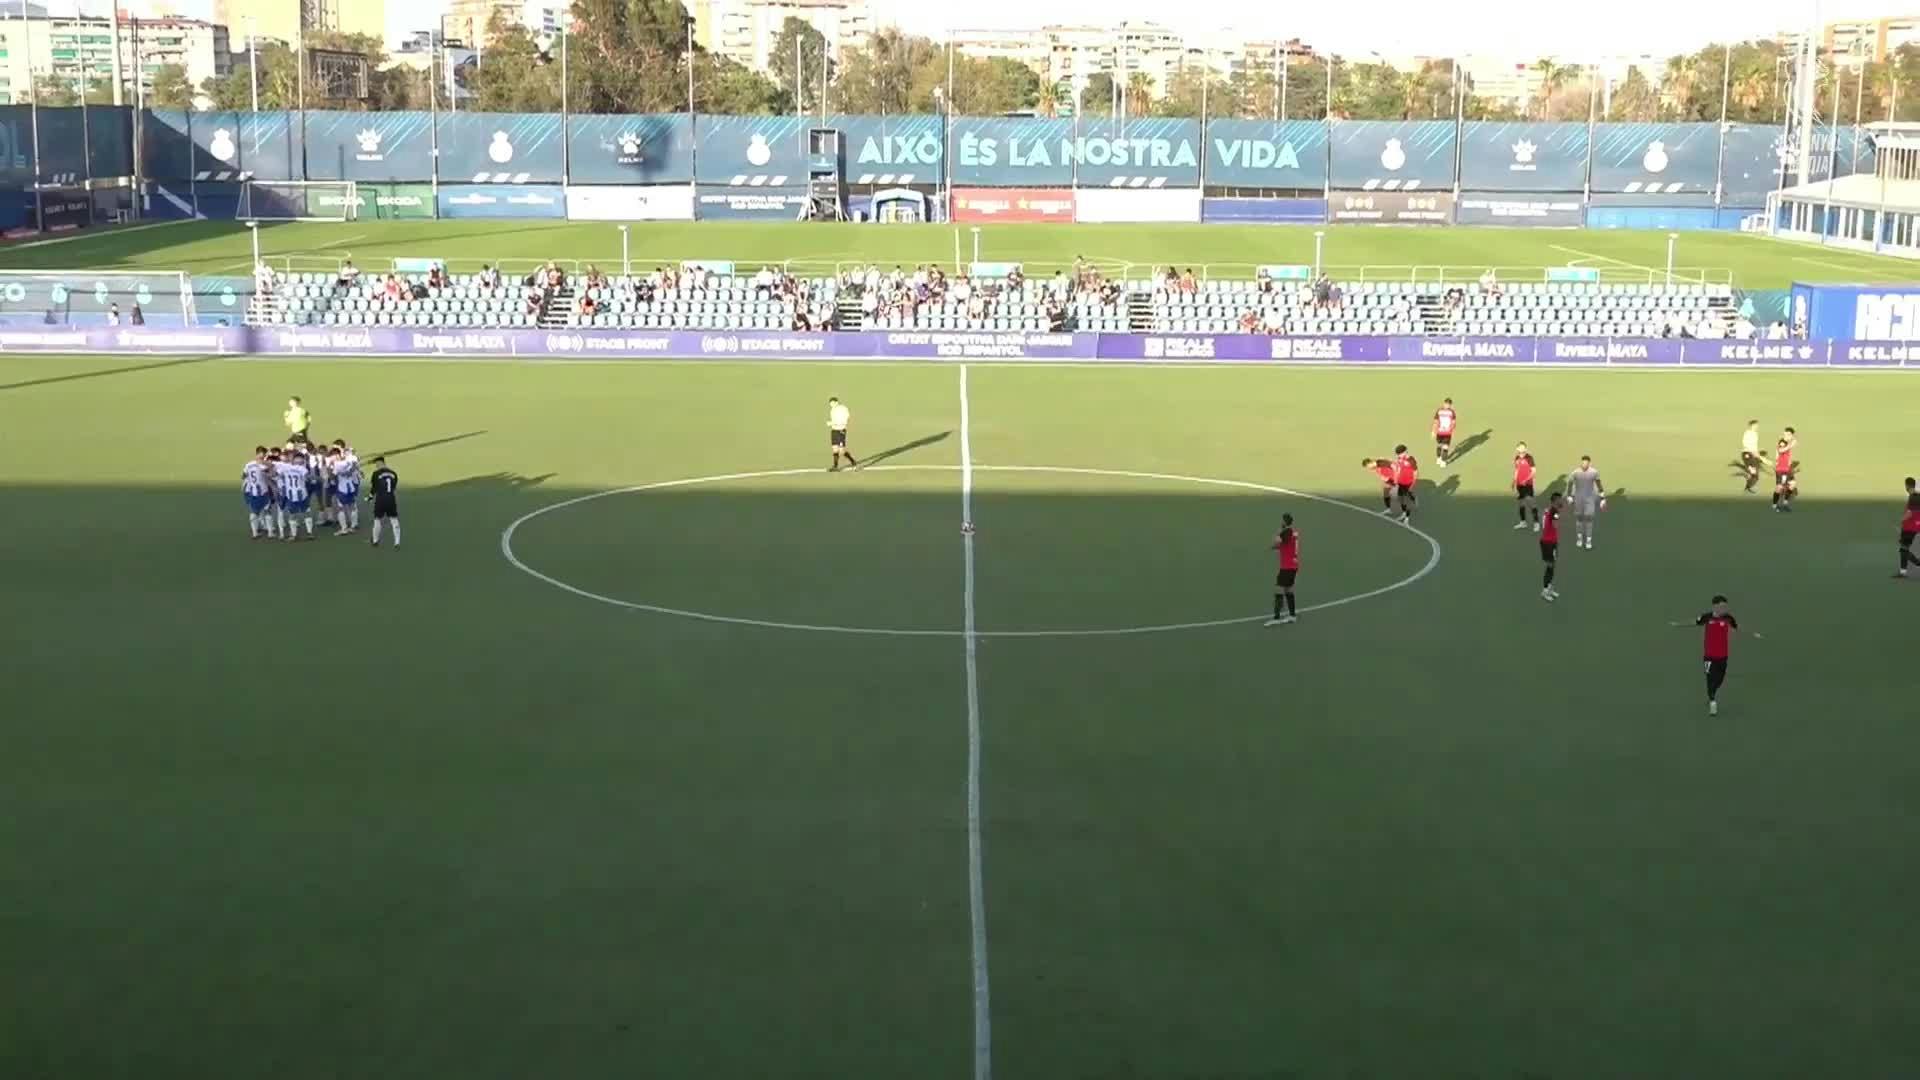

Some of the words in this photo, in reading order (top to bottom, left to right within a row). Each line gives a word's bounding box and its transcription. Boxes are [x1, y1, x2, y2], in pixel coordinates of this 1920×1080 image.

[857, 131, 943, 164] AIXÒ
[960, 132, 997, 166] ÉS
[1009, 138, 1052, 167] LA
[1061, 137, 1197, 167] NOSTRA
[1215, 139, 1300, 169] VIDA
[332, 333, 373, 347] MAYA
[465, 335, 505, 348] MAYA
[1475, 343, 1514, 357] MAYA
[1609, 344, 1648, 358] MAYA
[1721, 345, 1793, 360] KELME
[386, 478, 392, 493] 1
